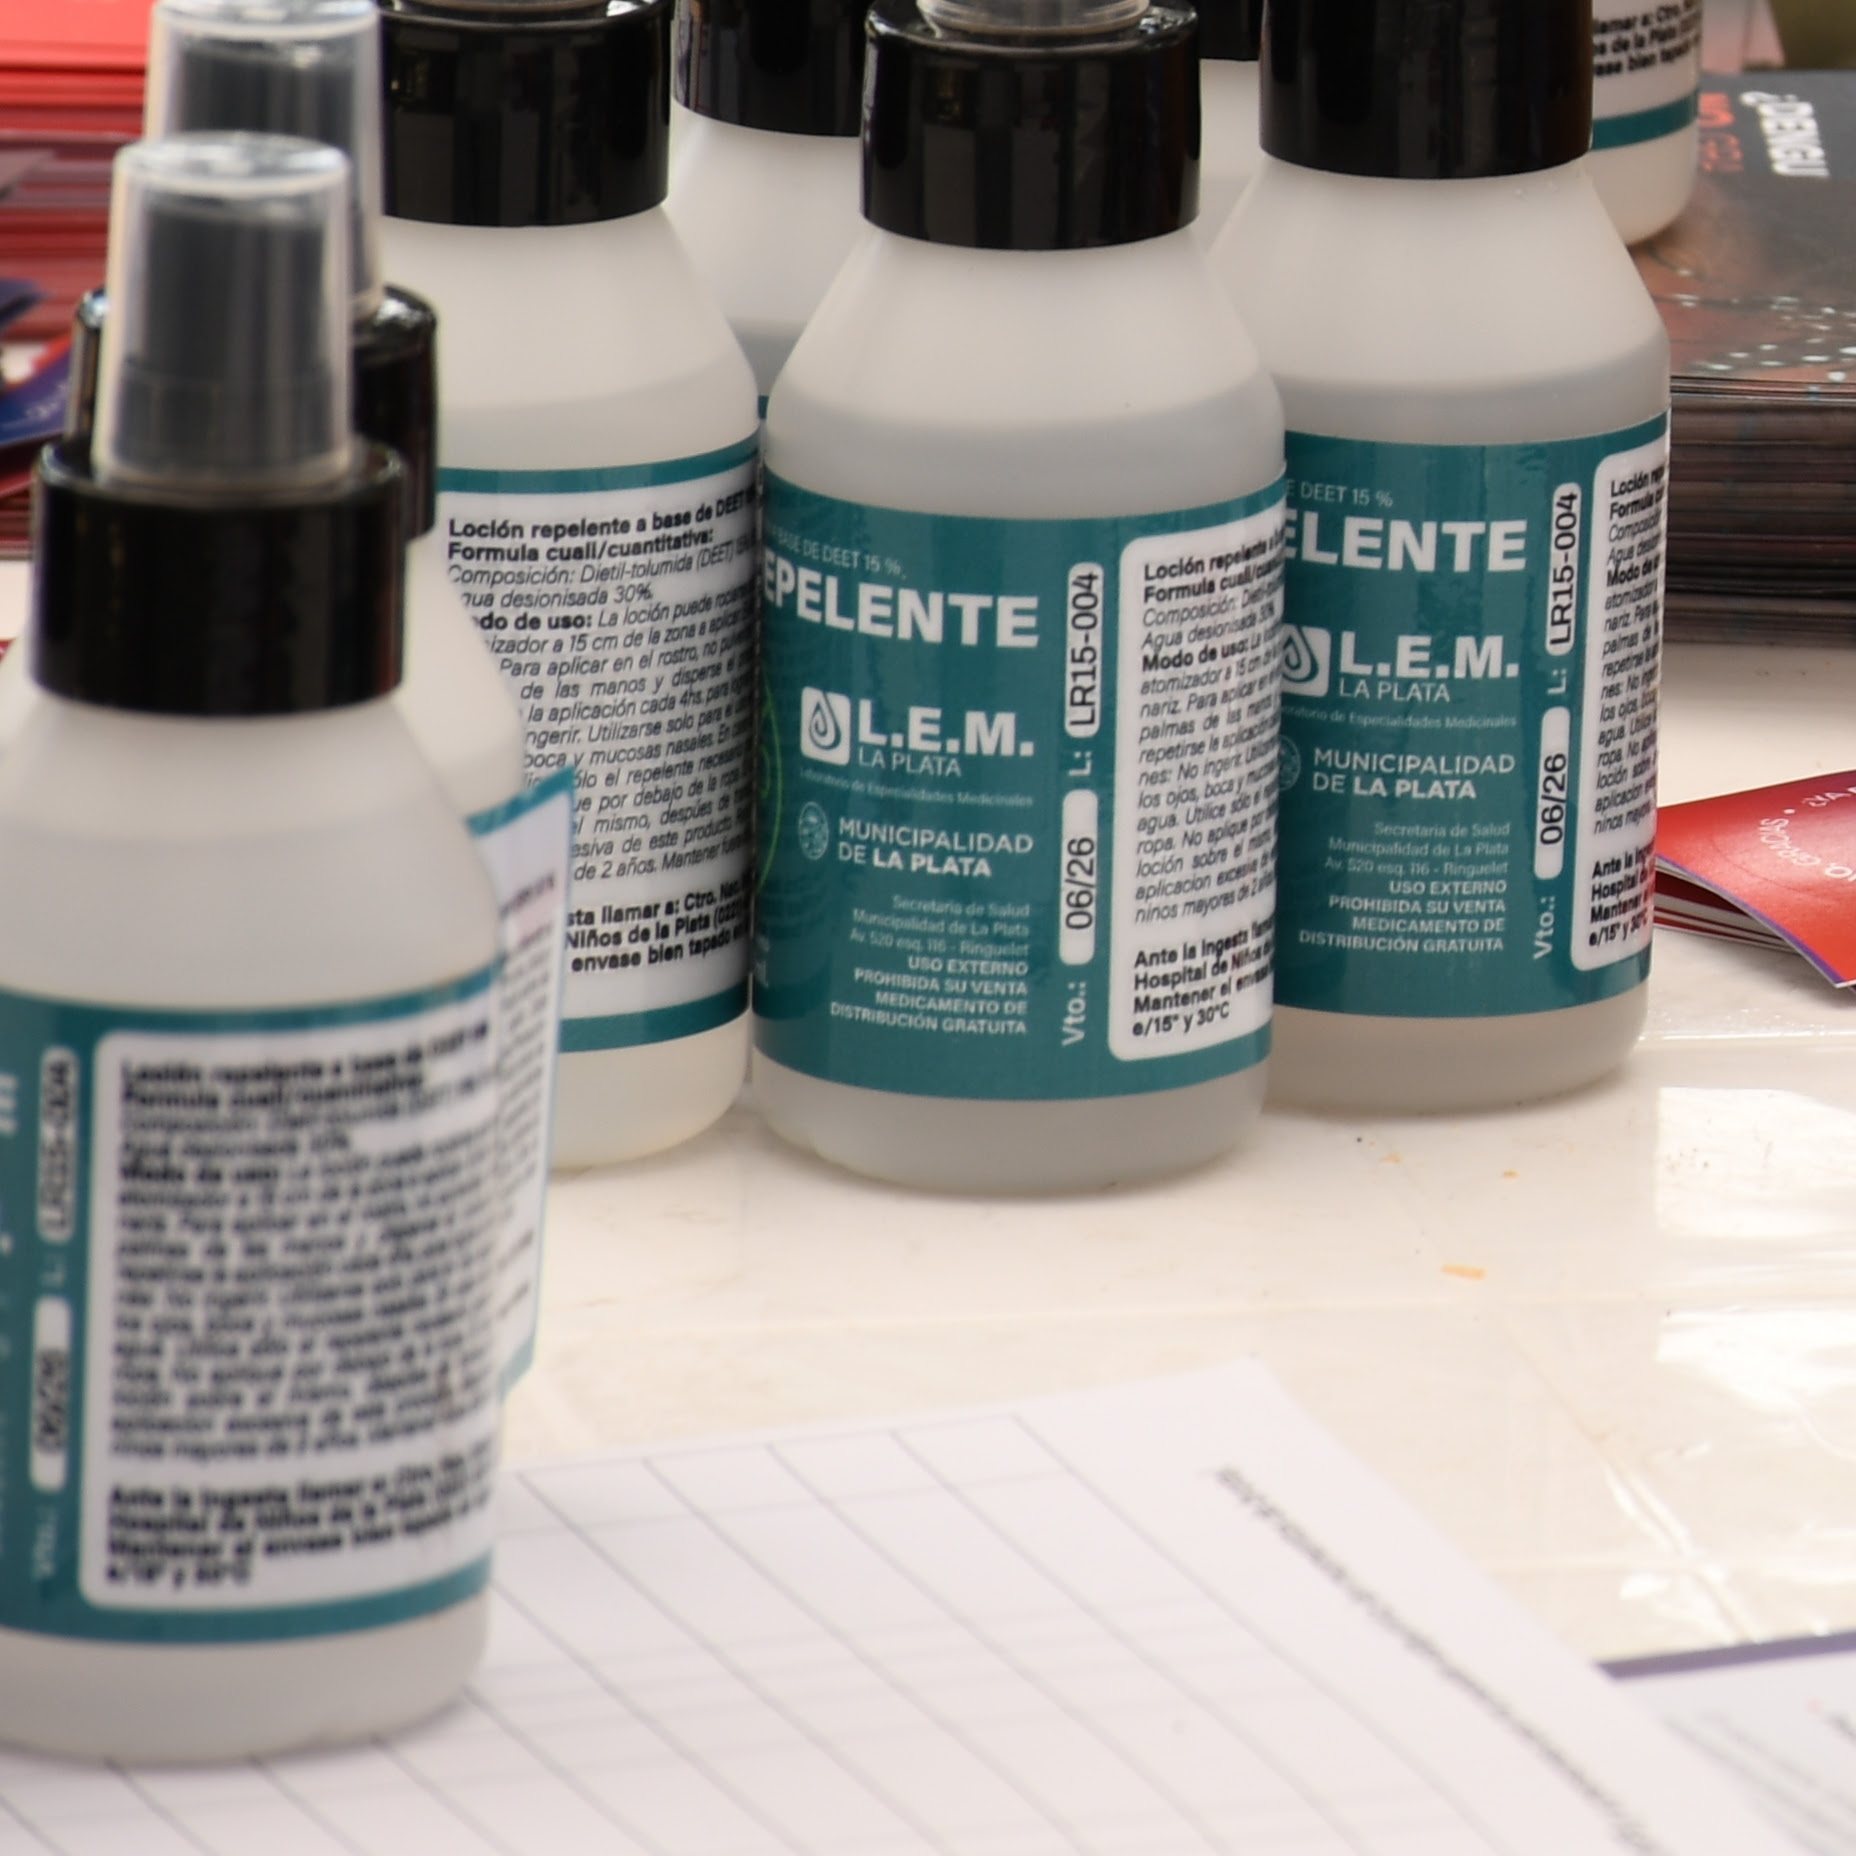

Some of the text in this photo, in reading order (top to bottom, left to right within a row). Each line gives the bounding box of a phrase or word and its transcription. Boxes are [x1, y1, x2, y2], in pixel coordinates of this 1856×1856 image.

[1301, 483, 1347, 503] DEET
[1352, 488, 1370, 506] 15
[449, 506, 692, 543] Loción repelente a base
[449, 542, 539, 562] Formula
[1285, 508, 1528, 573] ELENTE
[822, 543, 881, 570] DEET 15
[1144, 556, 1204, 581] Loción
[1549, 492, 1579, 646] LR15-004
[501, 586, 609, 608] desionisada
[763, 547, 1040, 648] EPELENTE
[1144, 579, 1215, 604] Formula
[514, 604, 670, 630] de uso: La loción
[570, 628, 642, 653] 15 cm de
[1069, 571, 1099, 727] LR15-004
[1142, 648, 1194, 672] Modo
[1340, 631, 1520, 679] L.E.M.
[1339, 678, 1450, 703] LA PLATA
[858, 698, 1035, 758] L.E.M.
[858, 748, 962, 777] LA PLATA
[1314, 747, 1515, 775] MUNICIPALIDAD
[1312, 771, 1477, 800] DE LA PLATA
[838, 816, 1034, 854] MUNICIPALIDAD
[838, 843, 992, 878] DE LA PLATA
[1532, 752, 1568, 961] Vto.: 06/26
[1389, 879, 1507, 896] USO EXTERNO
[1328, 894, 1506, 915] PROHIBIDA SU VENTA
[628, 928, 650, 943] de
[1352, 915, 1505, 934] MEDICAMENTO DE
[1062, 836, 1095, 1046] Vto.: 06/26
[1299, 929, 1504, 954] DISTRIBUCIÓN GRATUITA
[908, 955, 1028, 976] USO EXTERNO
[1134, 949, 1178, 969] Ante
[853, 967, 1028, 996] PROHIBIDA SU VENTA
[875, 990, 1027, 1015] MEDICAMENTO DE
[1133, 984, 1216, 1014] Mantener
[830, 1001, 1027, 1036] DISTRIBUCIÓN GRATUITA
